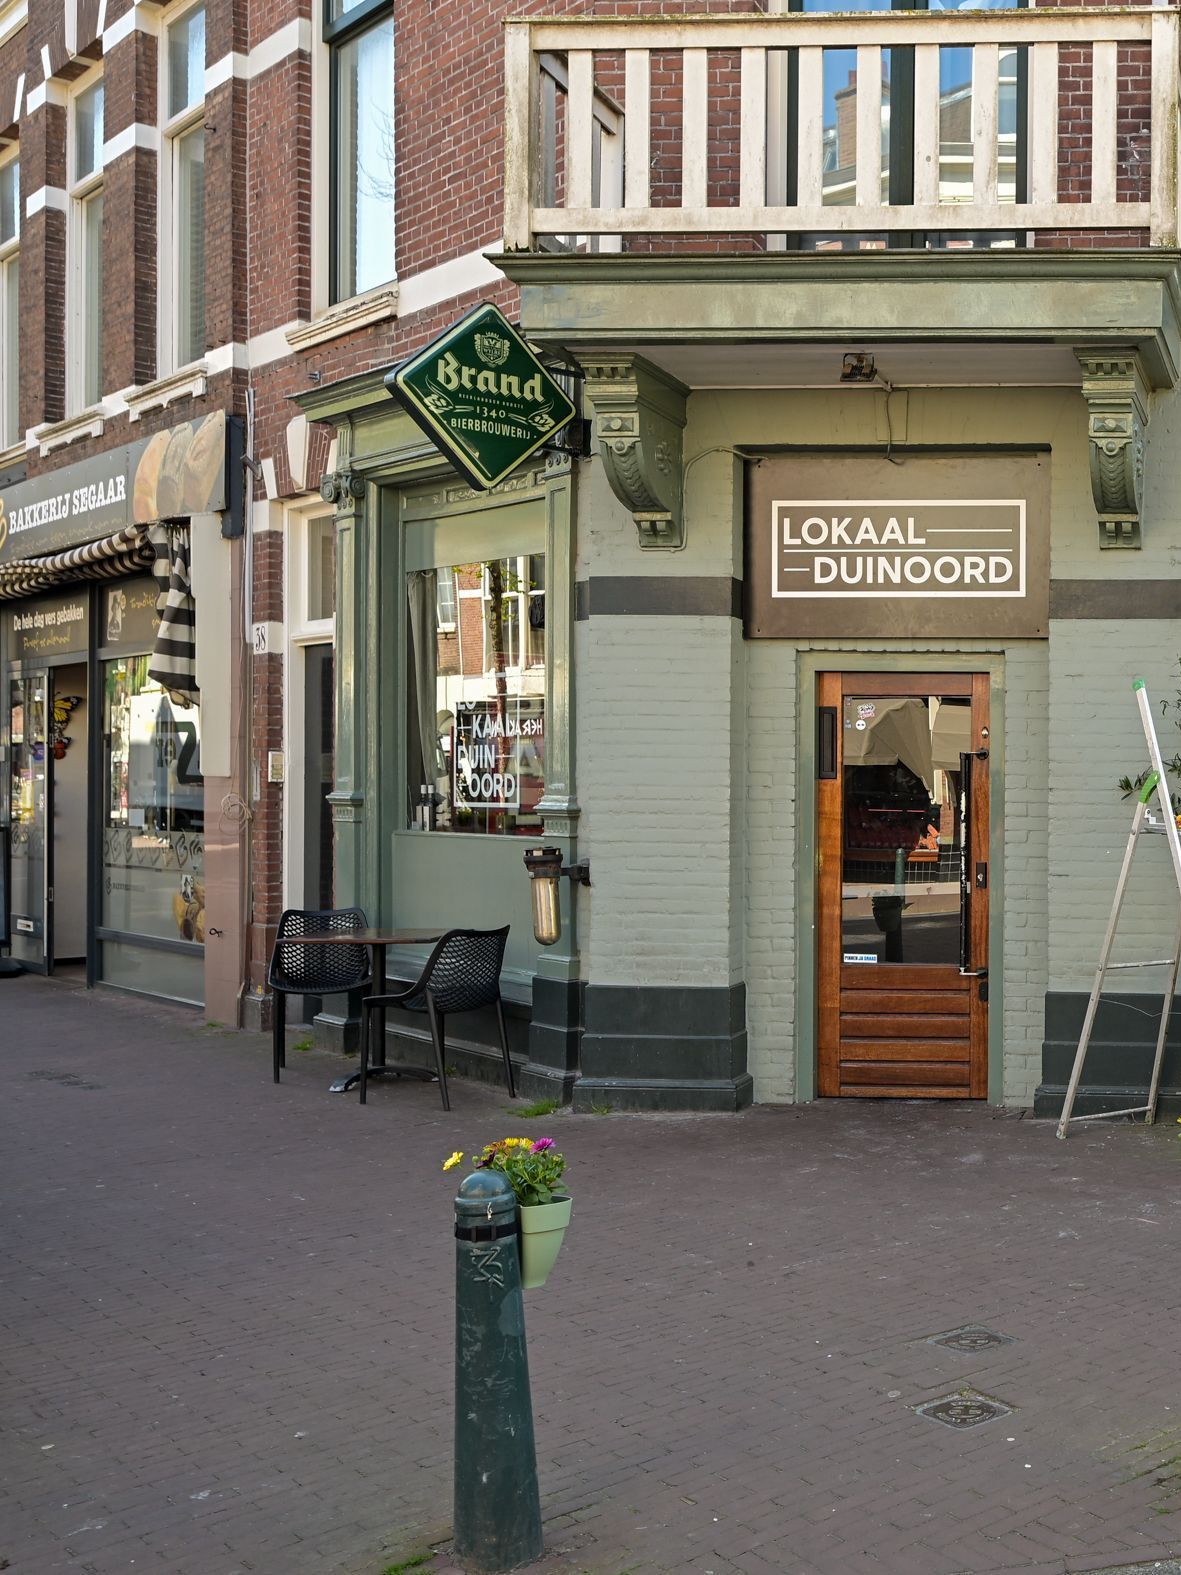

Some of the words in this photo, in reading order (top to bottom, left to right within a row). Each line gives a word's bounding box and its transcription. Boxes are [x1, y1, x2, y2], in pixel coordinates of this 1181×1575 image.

[437, 351, 546, 404] Brand
[476, 405, 506, 419] 1340
[450, 418, 531, 440] BIERBROUWERIJ
[9, 493, 71, 535] BAKKERIJ
[72, 475, 126, 516] SEGAAR
[783, 517, 926, 545] LOKAAL
[814, 556, 1013, 584] DUINOORD
[13, 614, 21, 631] De
[22, 612, 33, 630] hele
[34, 611, 44, 628] dag
[45, 611, 56, 625] vers
[57, 604, 84, 625] gebakken
[255, 625, 266, 651] 38
[472, 713, 514, 738] KAAL
[457, 744, 495, 769] DUIN
[468, 773, 516, 798] OORD
